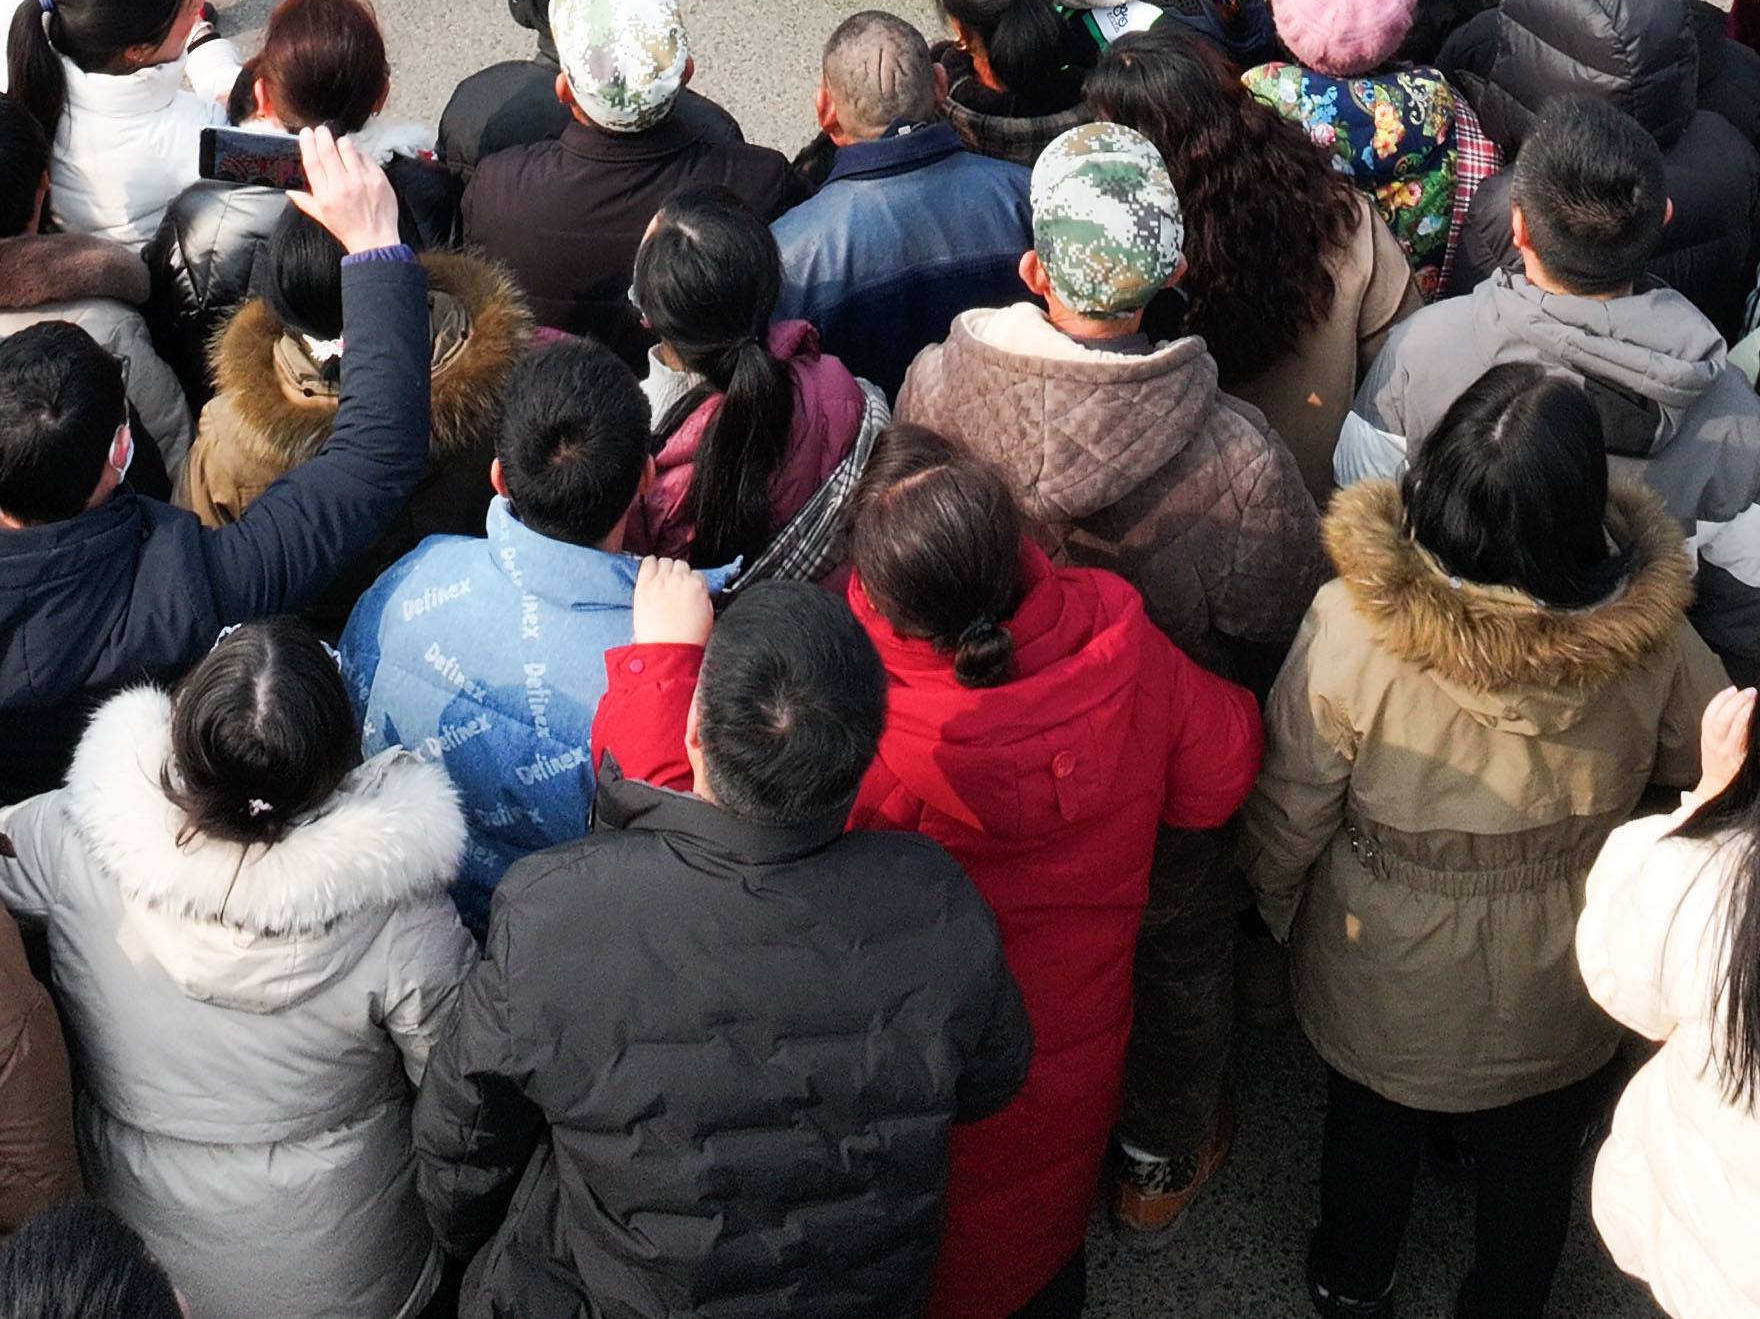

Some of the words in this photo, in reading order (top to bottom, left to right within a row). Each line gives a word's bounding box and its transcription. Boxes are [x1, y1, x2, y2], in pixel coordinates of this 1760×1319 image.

[401, 576, 473, 622] Definex
[422, 641, 487, 704] Definex
[424, 713, 492, 757] Definex
[514, 745, 590, 787] Definex
